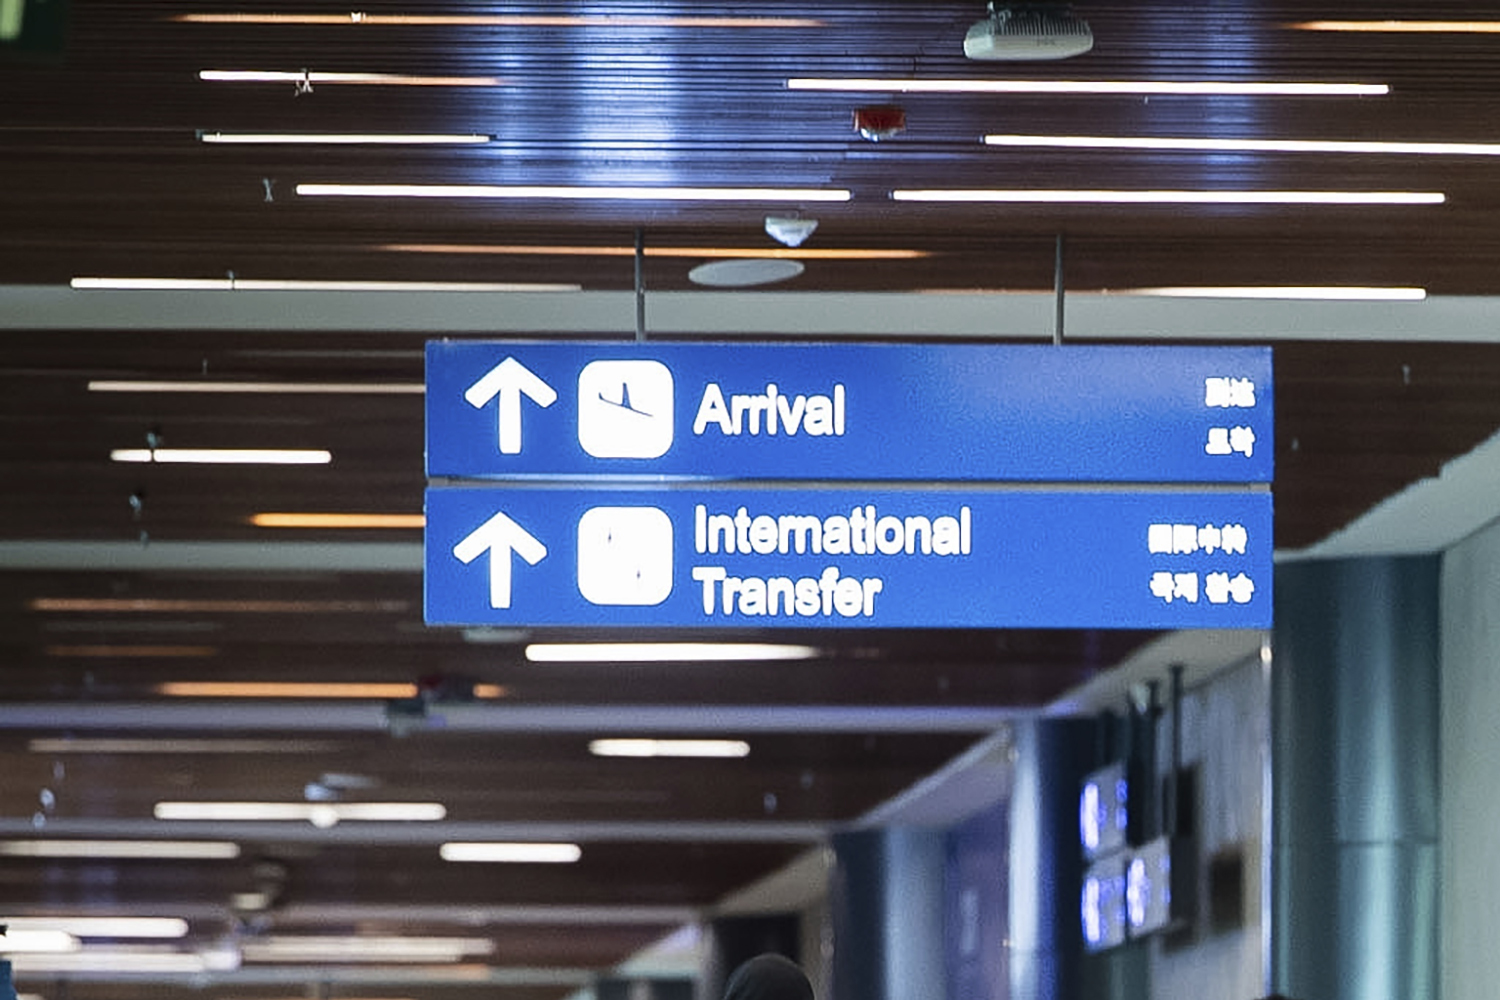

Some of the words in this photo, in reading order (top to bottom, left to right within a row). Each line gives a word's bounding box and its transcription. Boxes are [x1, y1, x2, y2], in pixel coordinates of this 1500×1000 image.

[693, 383, 845, 436] Arrival
[695, 505, 971, 556] International
[692, 566, 883, 617] Transfer
